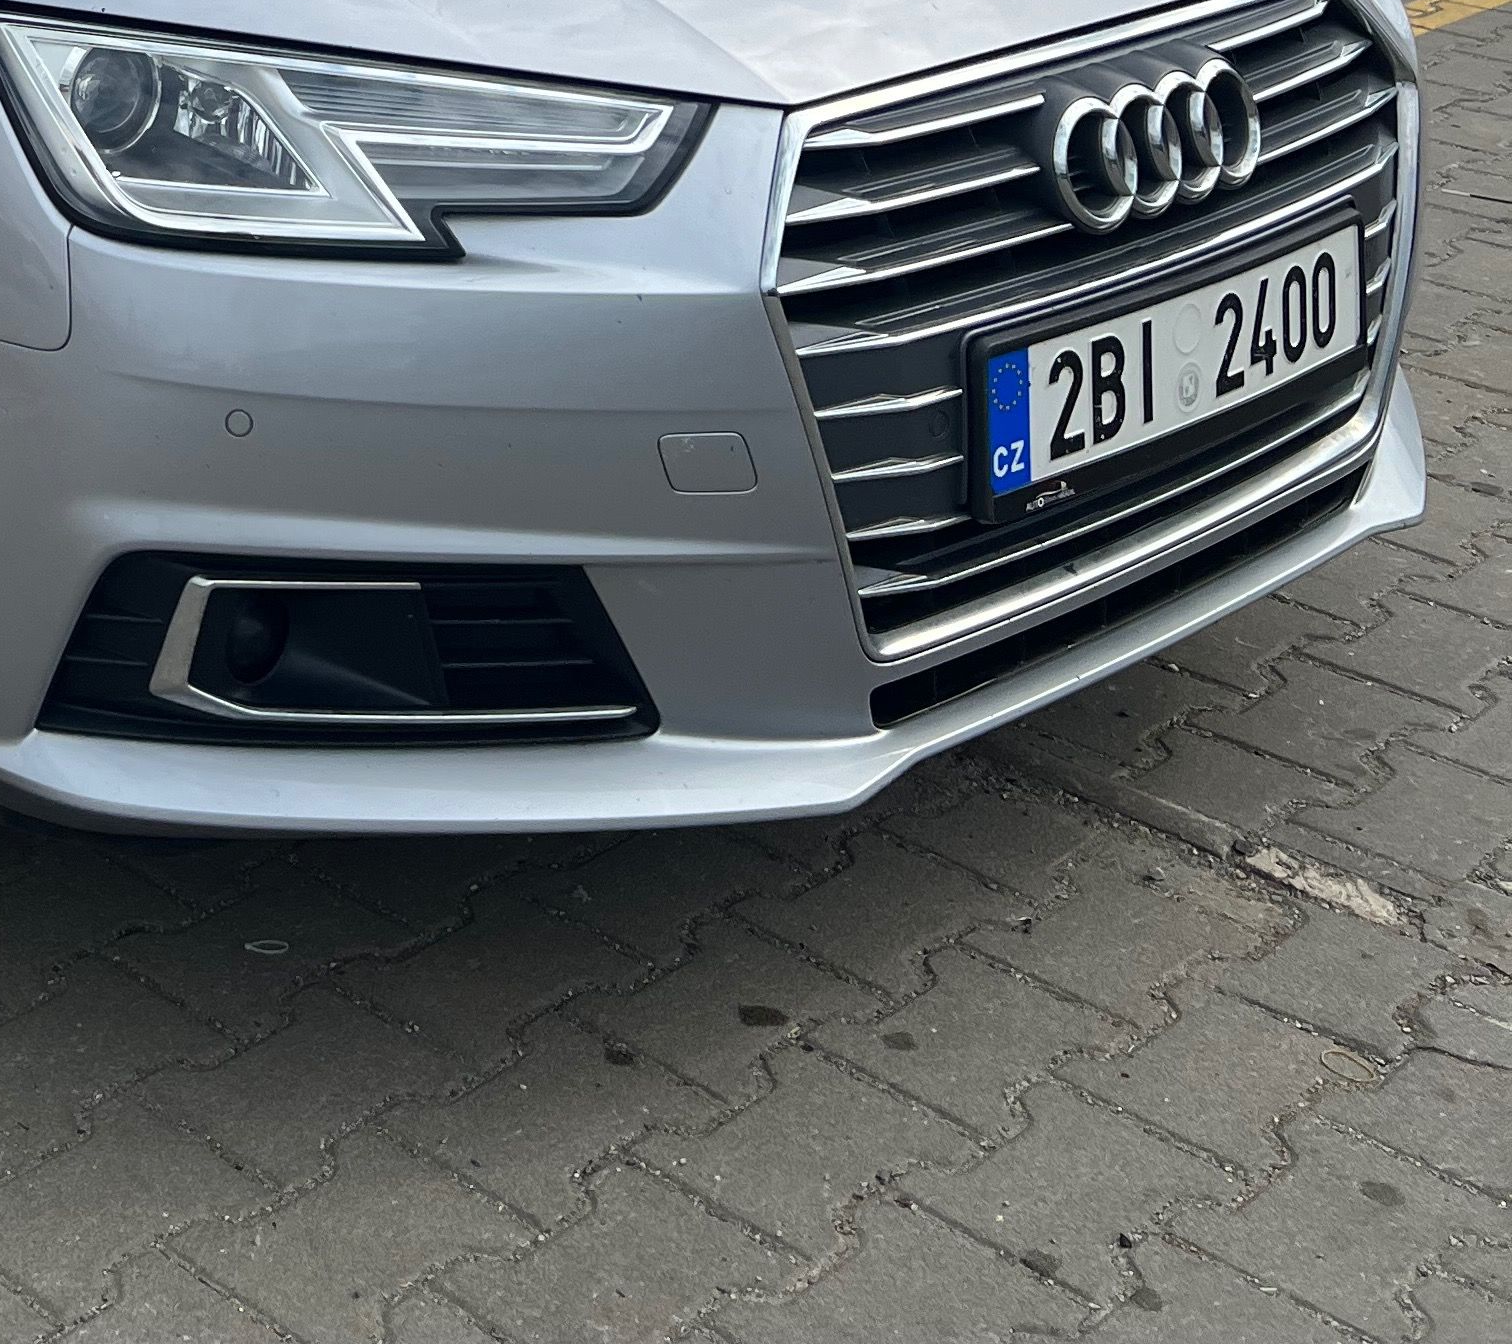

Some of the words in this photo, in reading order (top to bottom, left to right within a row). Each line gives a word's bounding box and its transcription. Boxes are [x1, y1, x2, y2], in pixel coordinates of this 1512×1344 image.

[1048, 319, 1154, 461] 2BI
[1214, 251, 1336, 398] 2400
[992, 440, 1025, 478] CZ
